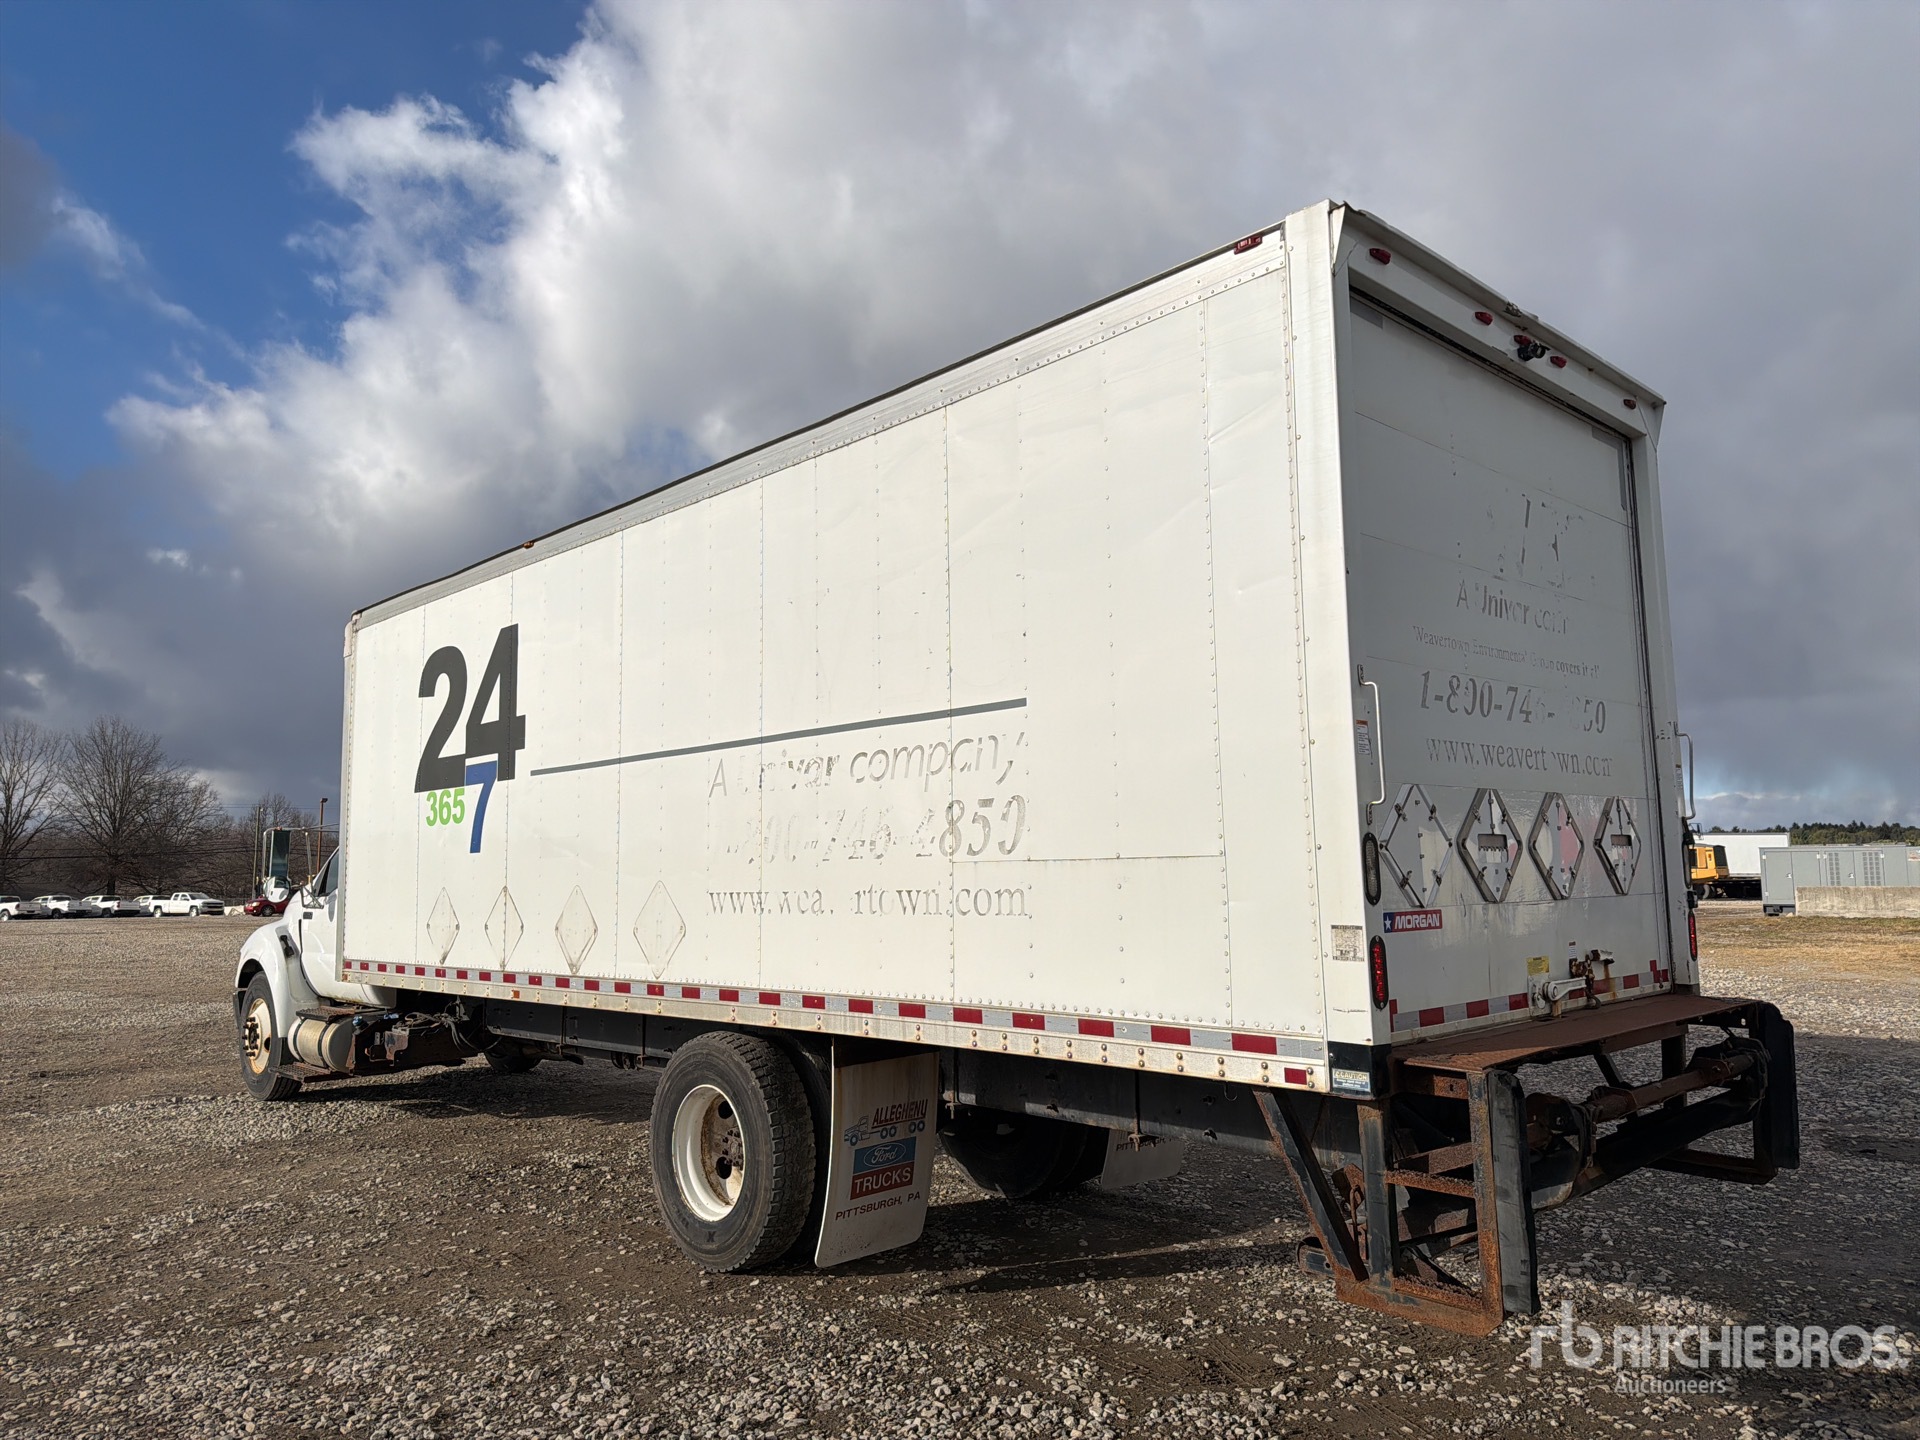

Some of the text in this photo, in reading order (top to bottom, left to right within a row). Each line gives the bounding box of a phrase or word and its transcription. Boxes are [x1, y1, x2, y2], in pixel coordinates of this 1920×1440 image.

[414, 623, 526, 793] 24
[708, 758, 728, 798] A
[426, 788, 466, 827] 365
[465, 760, 498, 854] 7
[1394, 913, 1441, 930] MORGAN
[871, 1144, 898, 1164] Ford
[855, 1167, 911, 1194] TRUCKS
[835, 1192, 921, 1221] PITTSBURGH, PA
